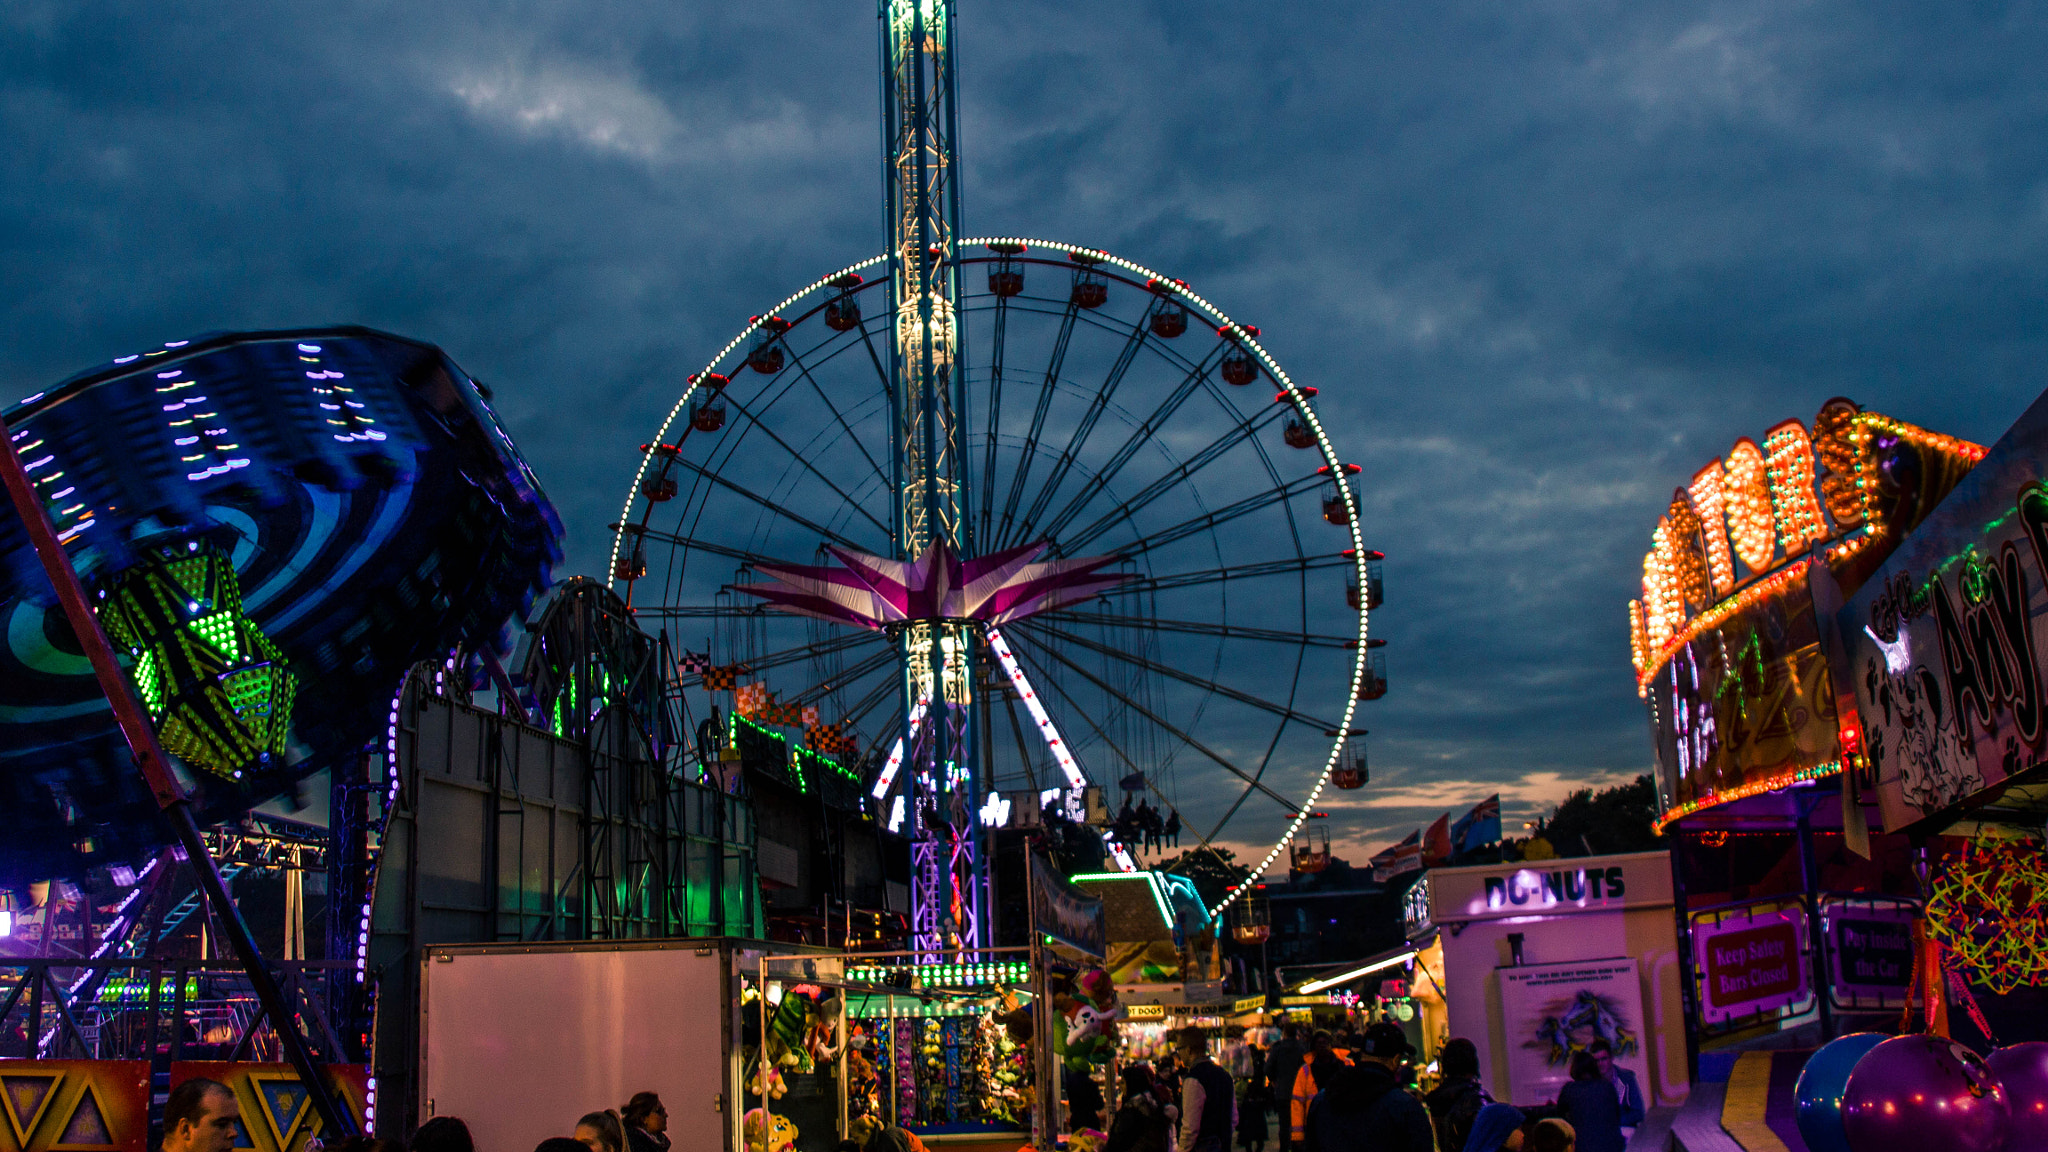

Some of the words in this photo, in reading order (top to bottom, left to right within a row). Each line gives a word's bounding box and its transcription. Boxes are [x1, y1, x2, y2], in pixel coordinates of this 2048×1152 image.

[1929, 541, 2042, 747] Any
[1715, 947, 1747, 967] Keep
[1749, 938, 1786, 961] Safety
[1844, 927, 1867, 954] Pay
[1718, 973, 1748, 995] Bars
[1750, 962, 1789, 987] Closed
[1856, 957, 1876, 977] the
[1879, 957, 1901, 978] Car
[1138, 1006, 1162, 1015] DOGS
[1174, 1006, 1191, 1015] HOT
[1200, 1006, 1218, 1015] COLD
